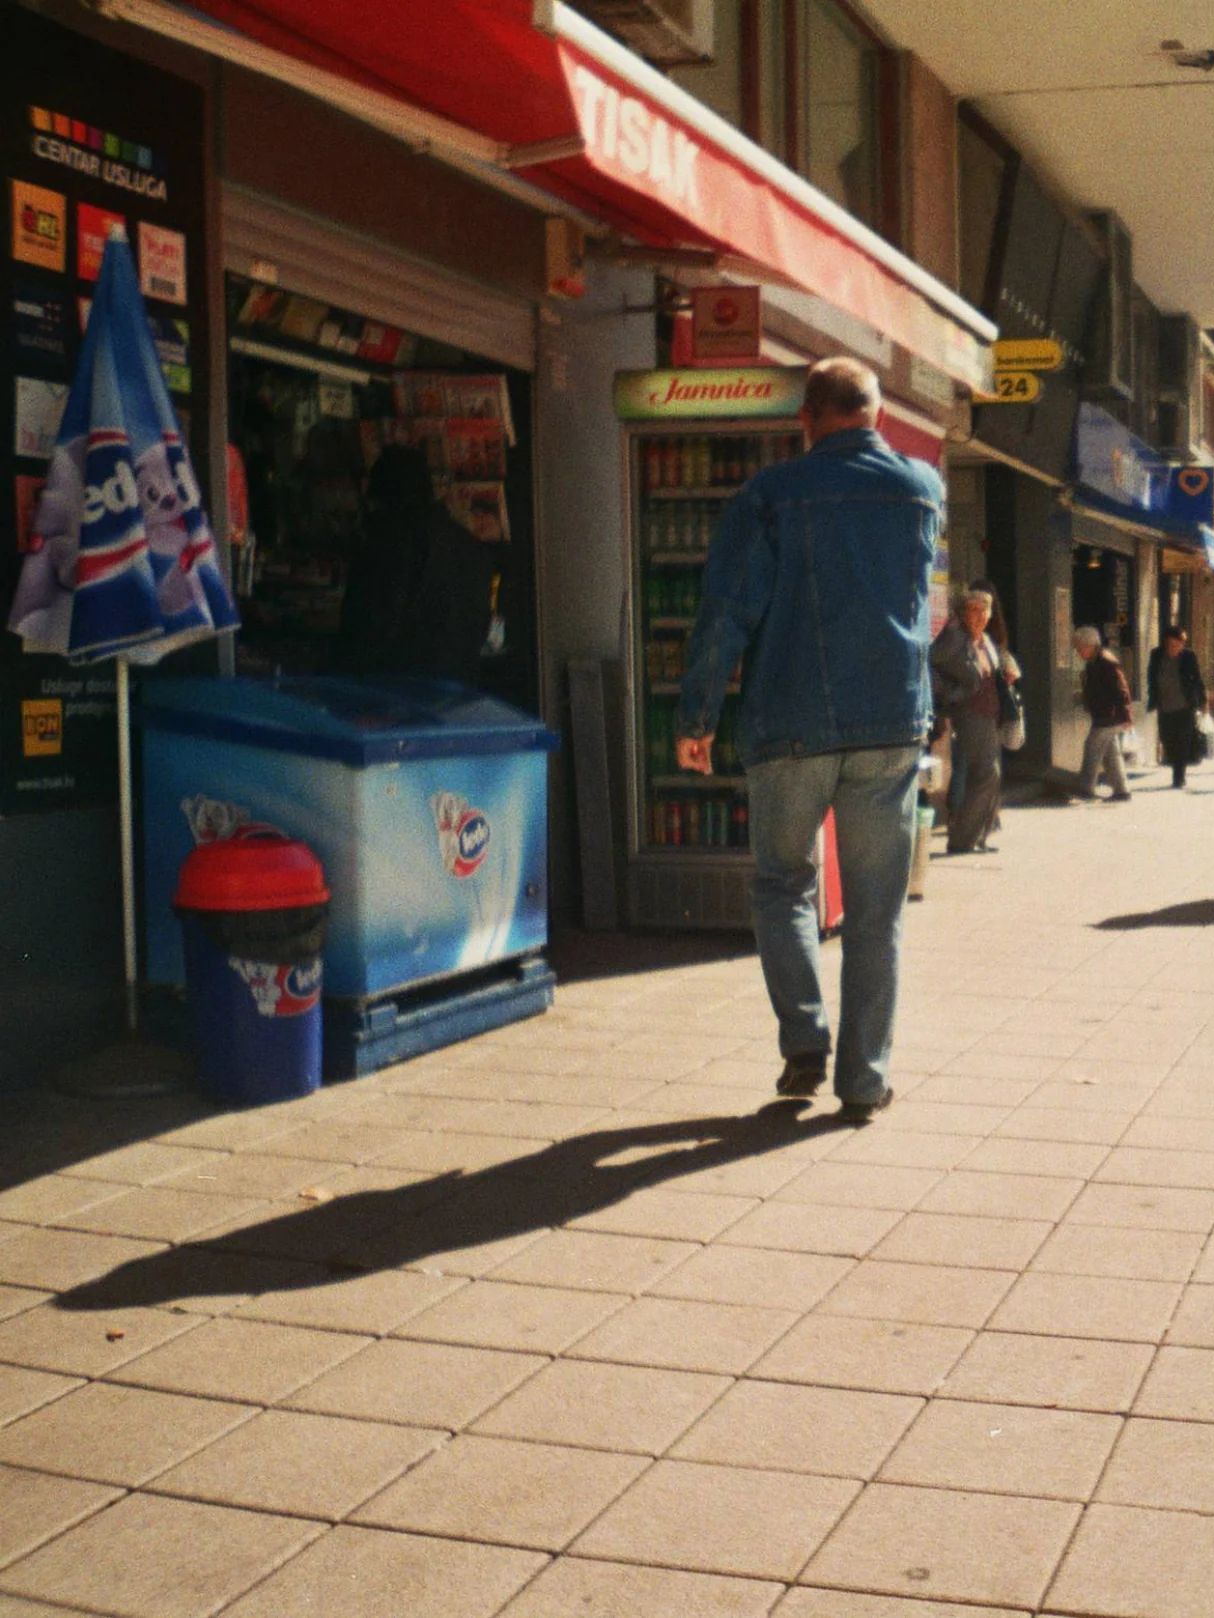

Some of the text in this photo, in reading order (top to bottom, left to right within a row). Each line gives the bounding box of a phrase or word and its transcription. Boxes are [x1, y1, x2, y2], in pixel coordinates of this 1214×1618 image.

[574, 64, 700, 212] TISAK
[32, 134, 168, 202] CENTAR USLUGA
[648, 377, 773, 405] Jamnica
[1000, 377, 1029, 397] 24
